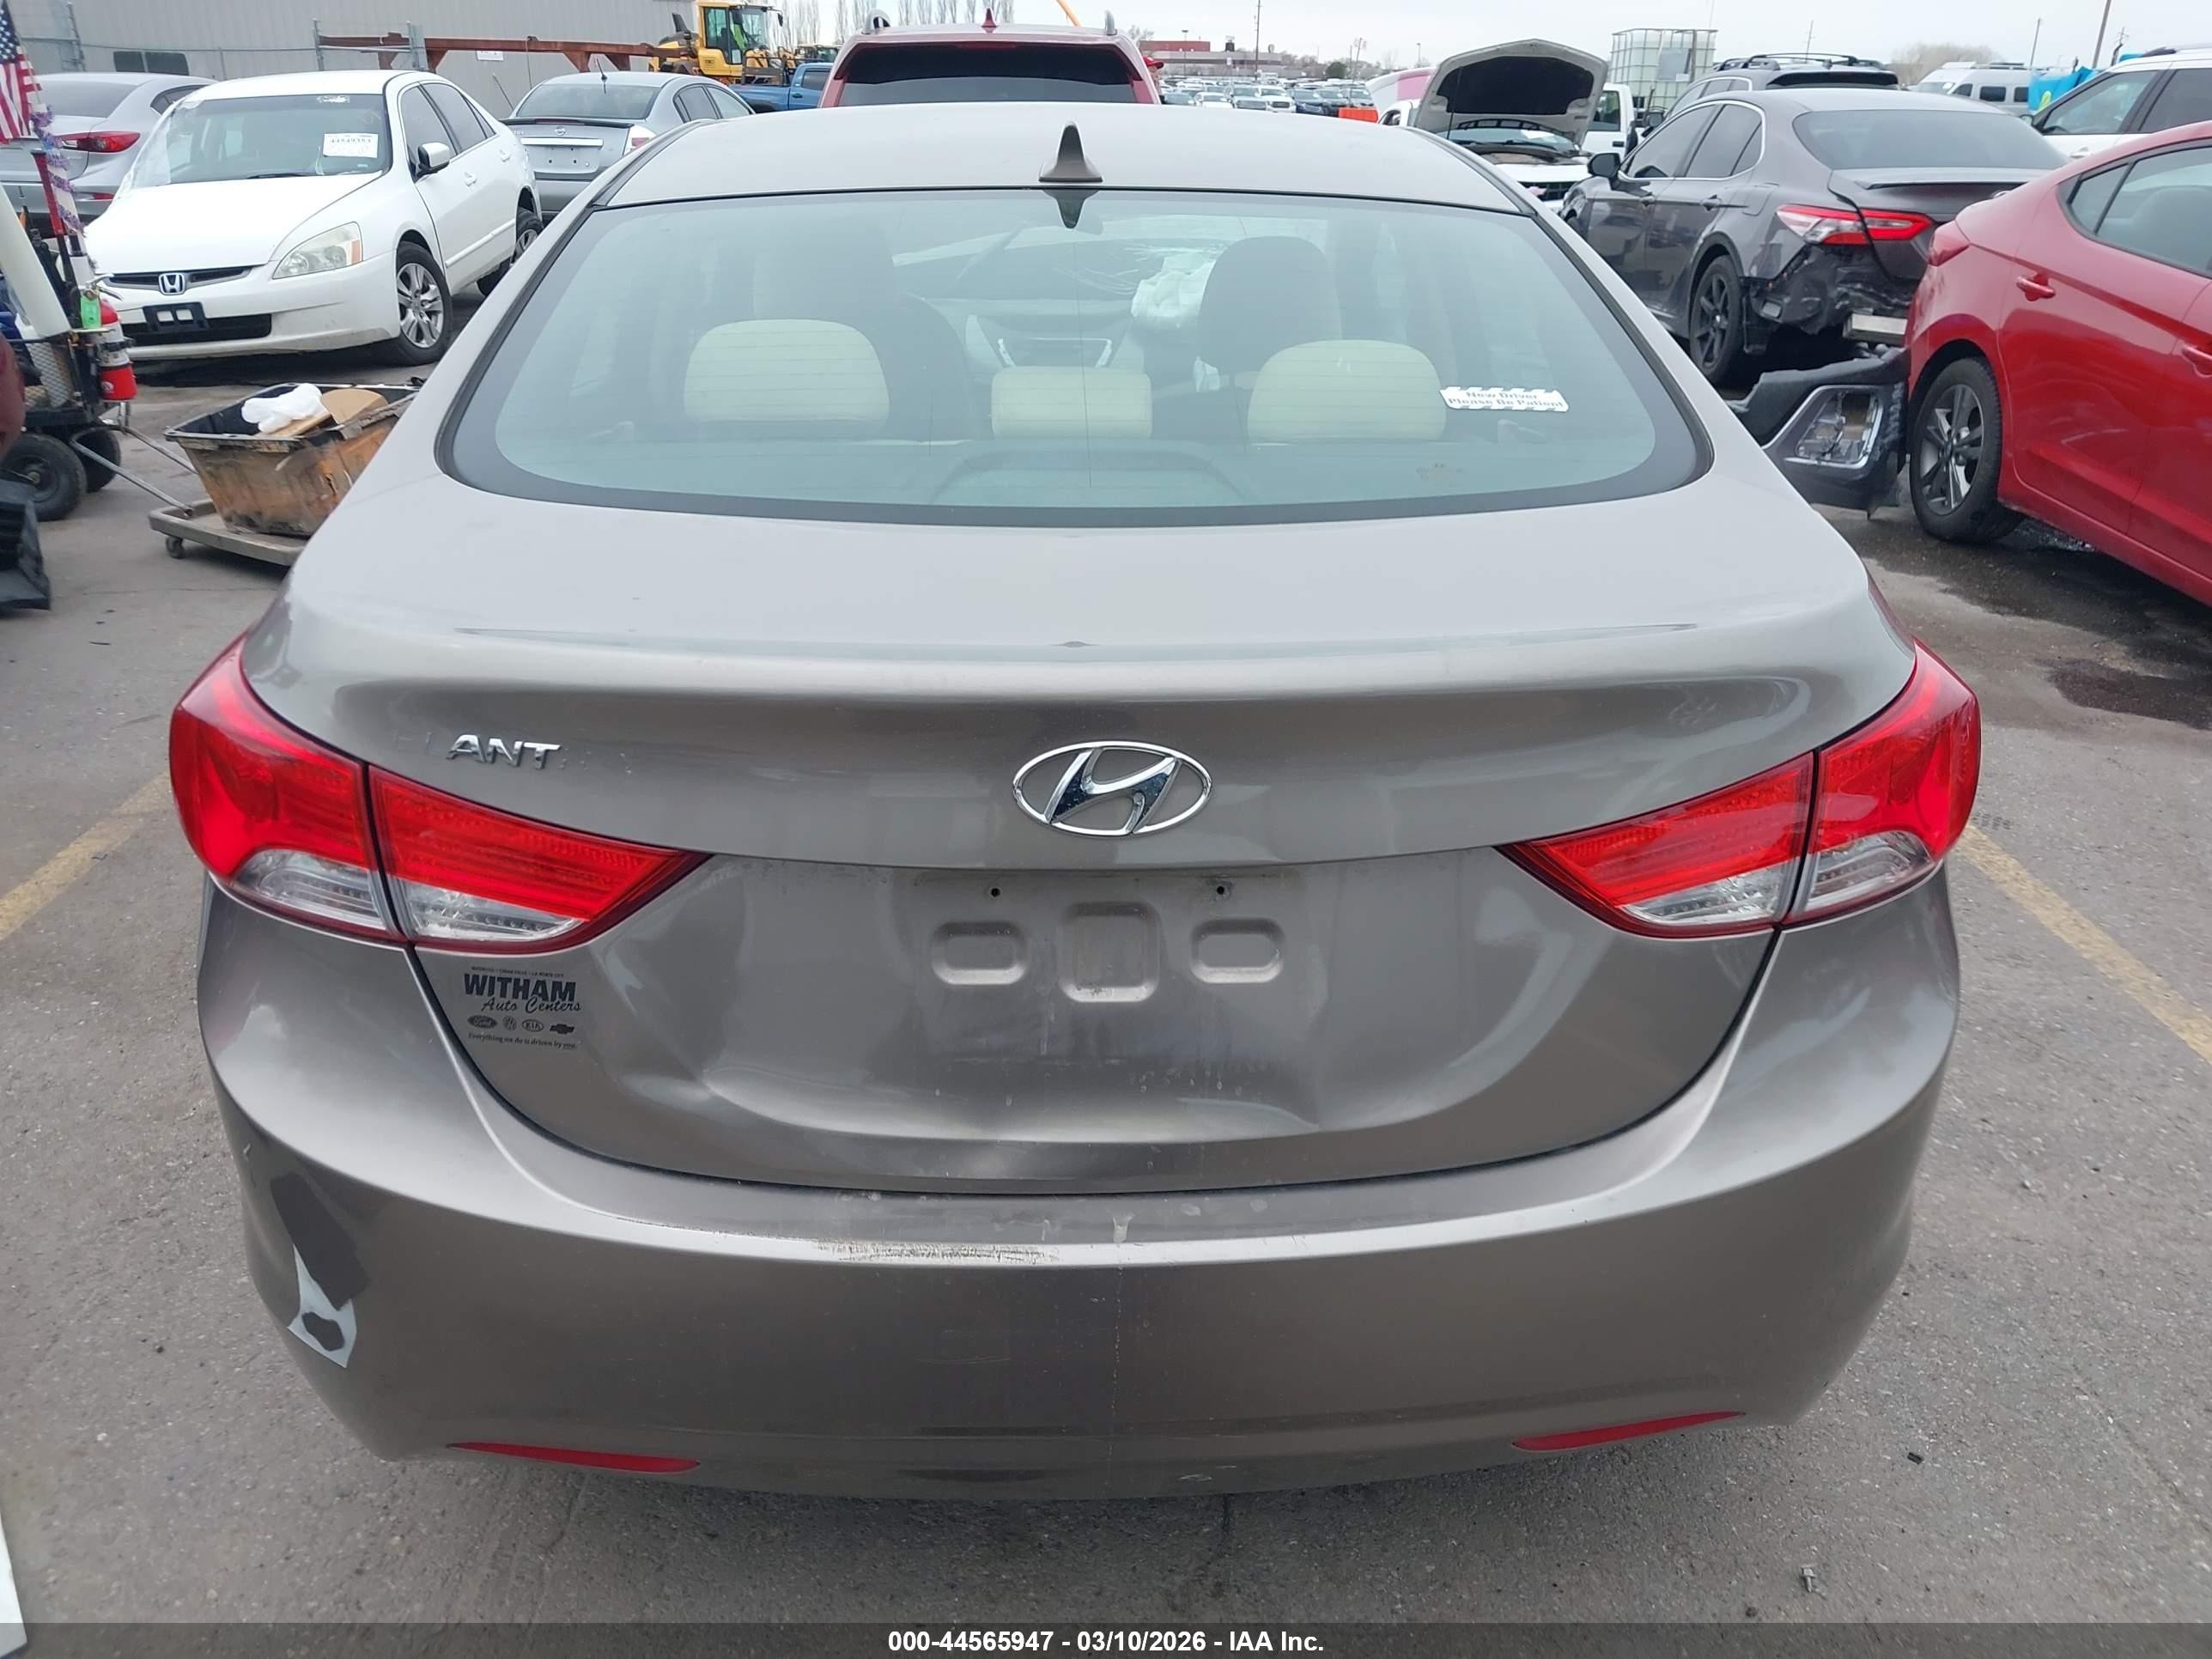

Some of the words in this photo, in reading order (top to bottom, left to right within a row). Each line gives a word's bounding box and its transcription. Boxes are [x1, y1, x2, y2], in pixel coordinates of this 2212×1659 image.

[1516, 398, 1565, 408] Patient
[446, 733, 562, 770] ANT
[464, 972, 577, 1002] WITHAM
[481, 997, 519, 1012] Auto
[525, 996, 582, 1014] Centers
